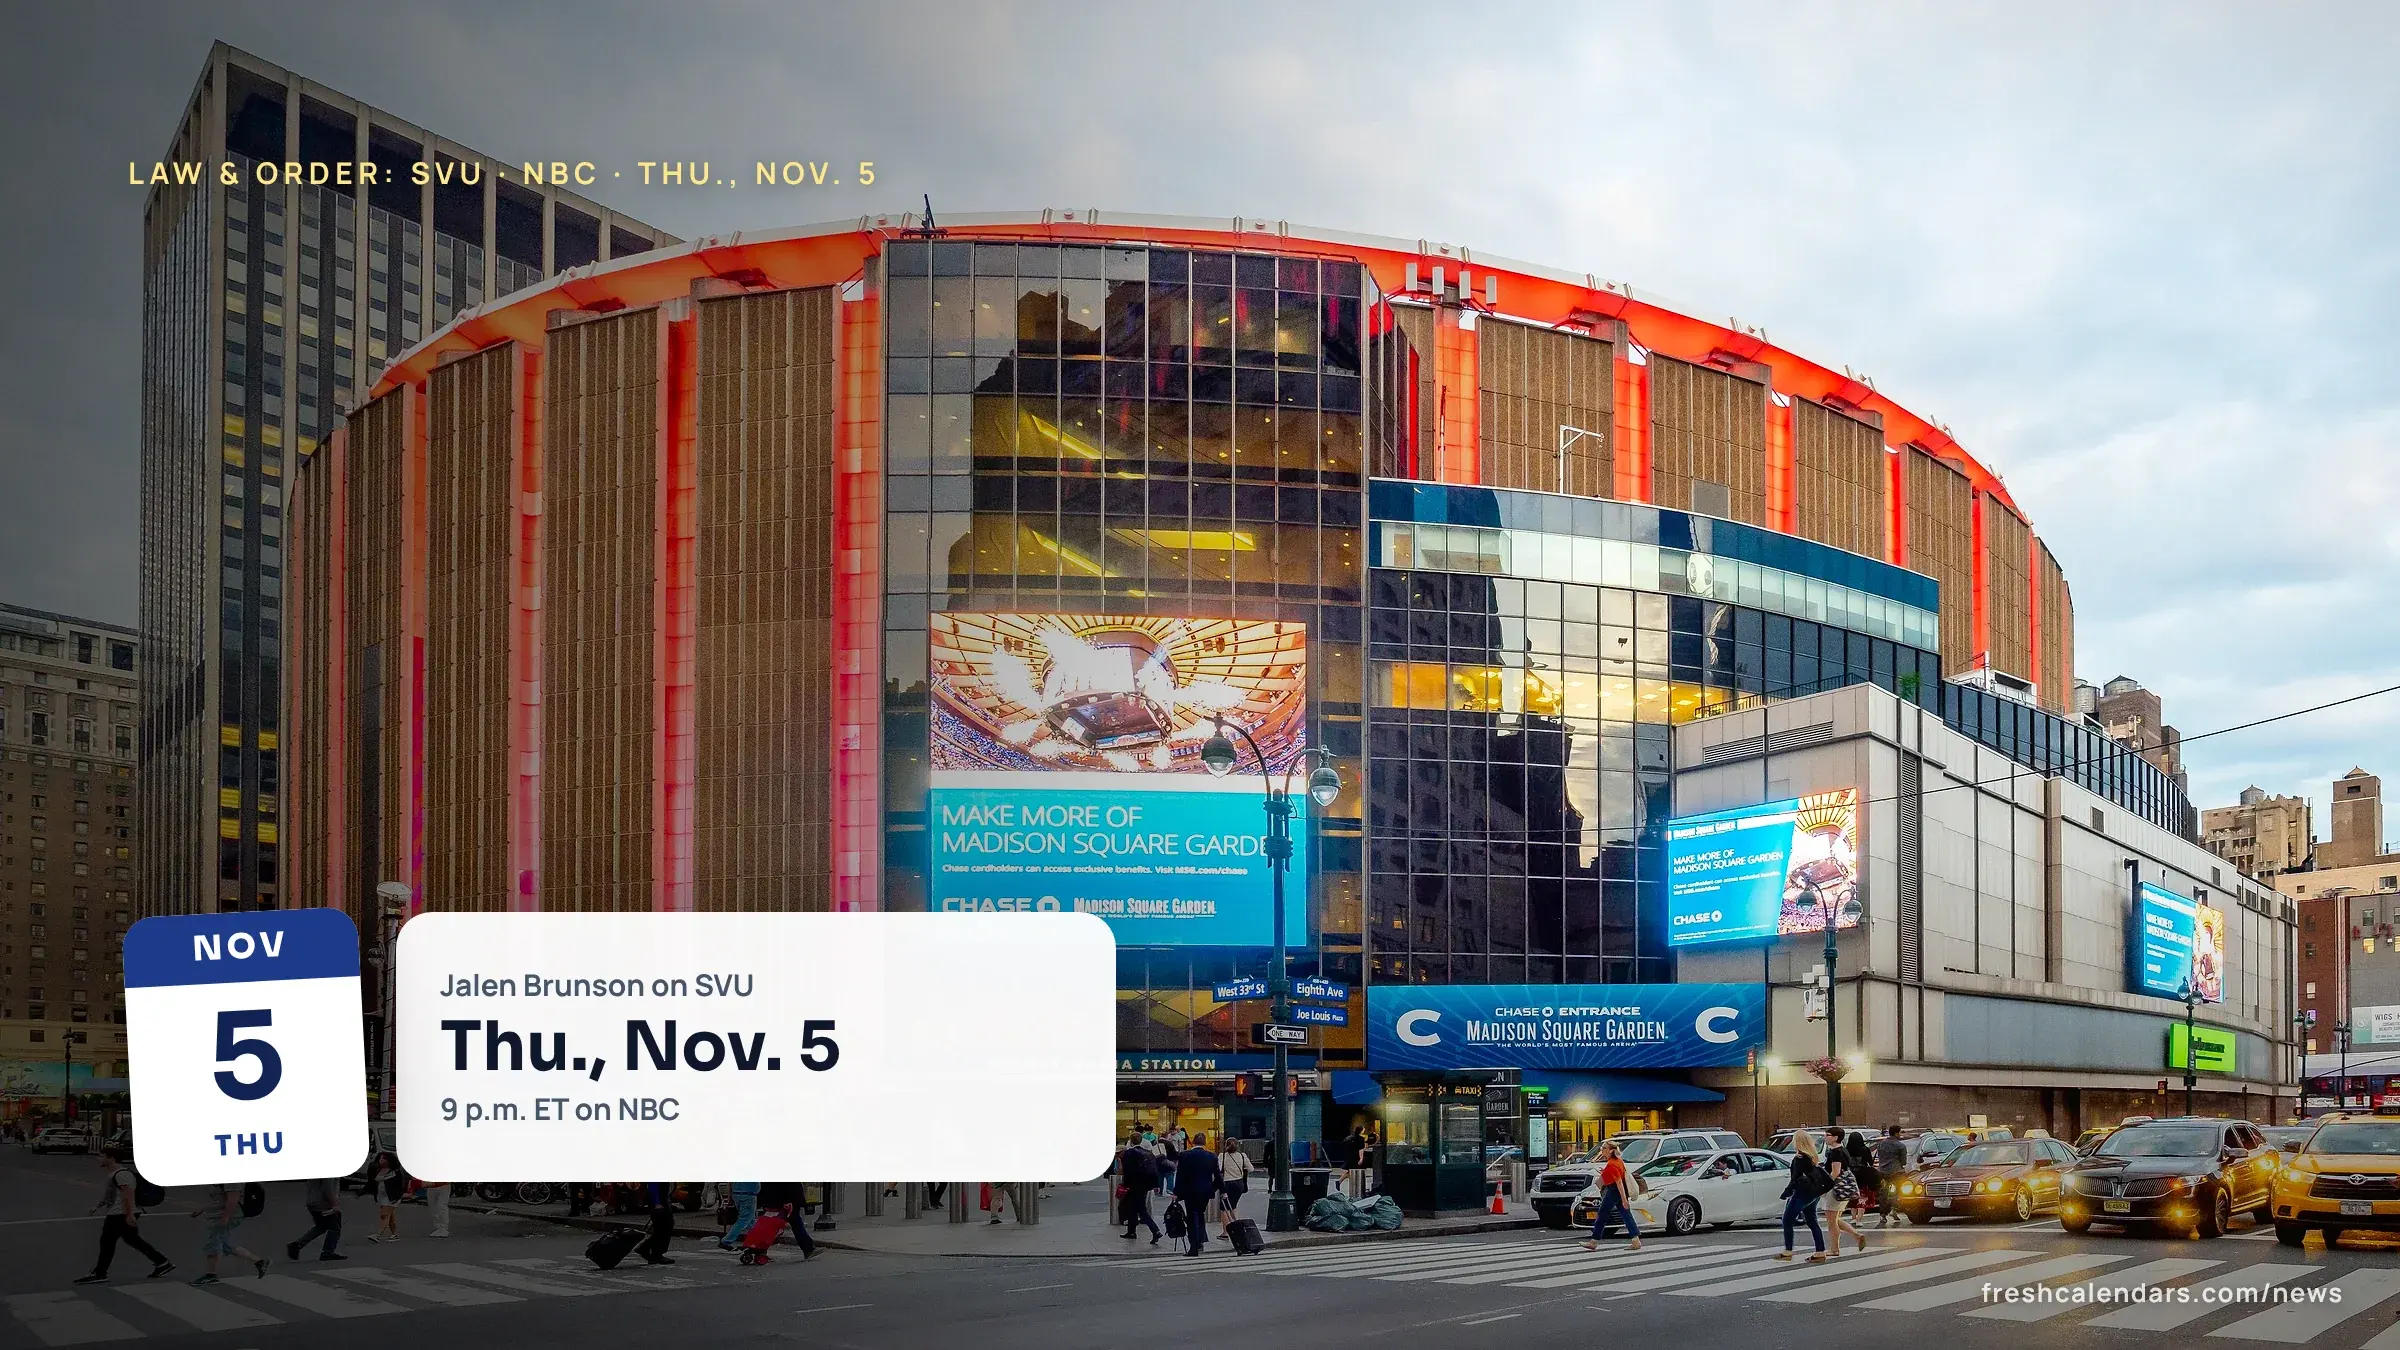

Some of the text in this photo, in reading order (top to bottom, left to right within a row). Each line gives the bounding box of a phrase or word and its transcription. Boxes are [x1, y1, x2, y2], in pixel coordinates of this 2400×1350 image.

[942, 804, 1143, 828] MAKE MORE OF
[942, 831, 1268, 859] MADISON SQUARE GARDE
[1673, 849, 1735, 866] MAKE MORE OF
[1673, 851, 1783, 874] MADISON SQUARE GARDEN
[942, 864, 969, 873] Chase
[970, 864, 1023, 873] cardholders
[1025, 865, 1041, 873] can
[1043, 865, 1072, 873] access
[1073, 865, 1113, 873] exclusive
[1155, 865, 1174, 874] Visit
[942, 897, 1032, 912] CHASE
[1073, 897, 1124, 914] MADISON
[1127, 897, 1169, 915] SQUARE
[1673, 912, 1711, 926] CHASE
[1217, 983, 1265, 998] West 33rd St
[1296, 983, 1344, 998] Eighth Ave
[1296, 1009, 1310, 1020] Joe
[1311, 1010, 1331, 1021] Louis
[1495, 1006, 1641, 1017] CHASE ENTRANCE
[2375, 1013, 2393, 1021] WIGS
[1271, 1029, 1302, 1038] ONE WAY
[1466, 1020, 1537, 1041] MADISON
[1542, 1019, 1600, 1042] SQUARE
[1141, 1059, 1216, 1070] STATION
[1462, 1086, 1477, 1095] TAXI
